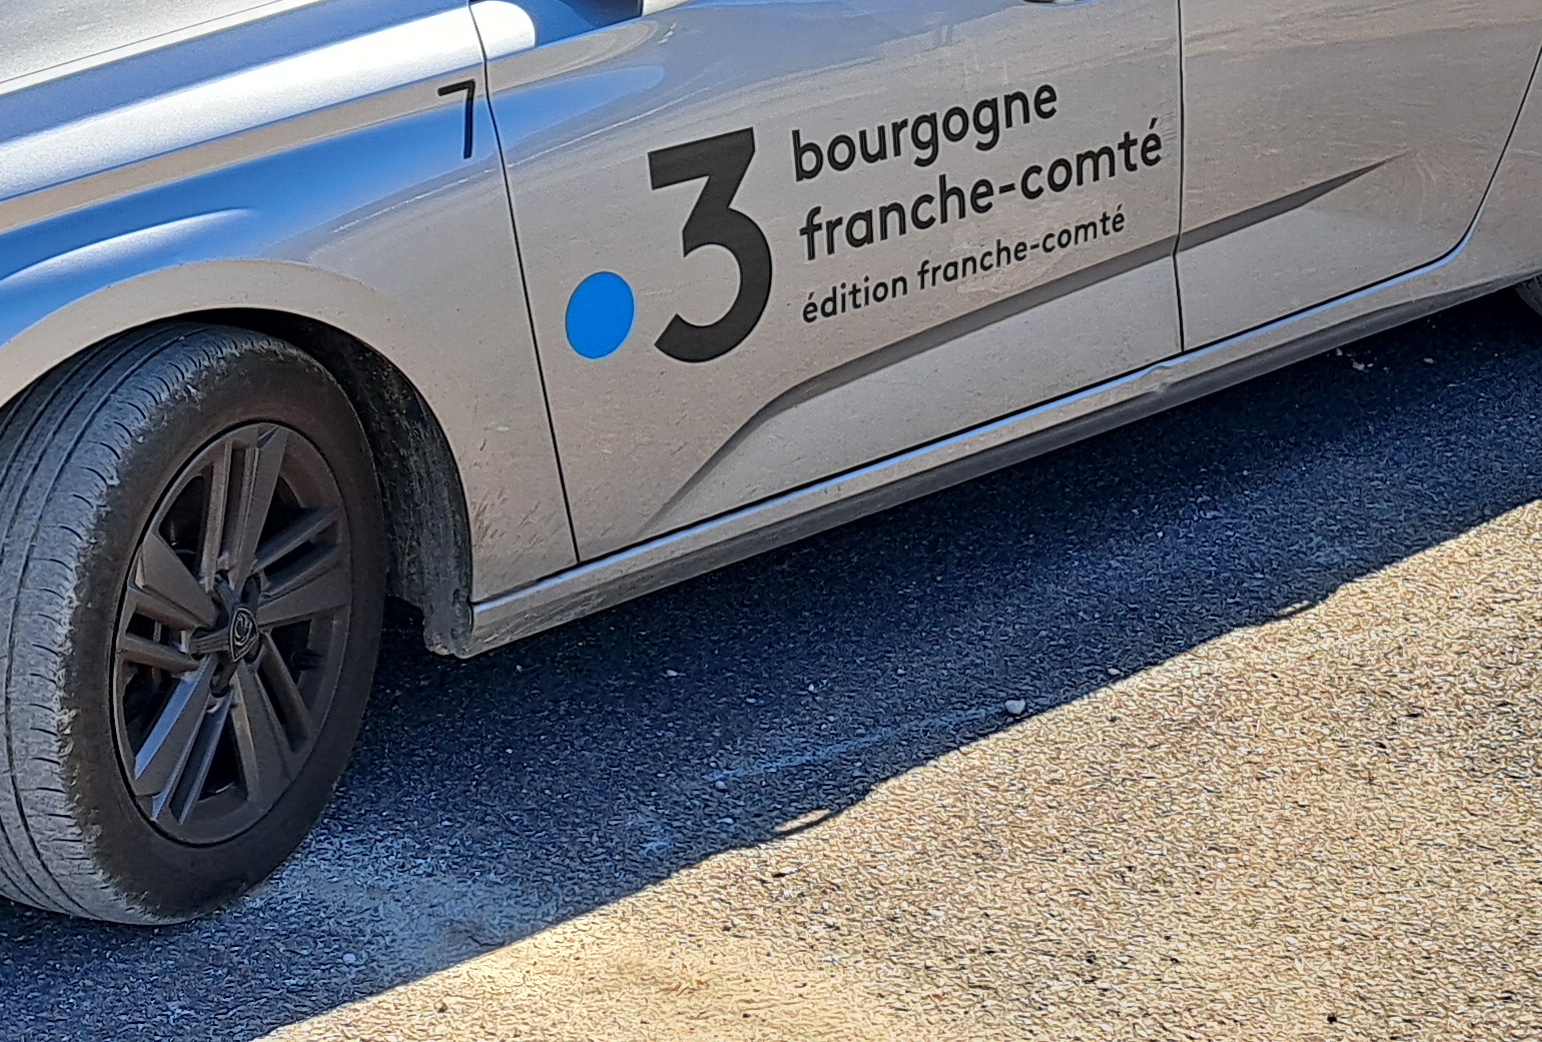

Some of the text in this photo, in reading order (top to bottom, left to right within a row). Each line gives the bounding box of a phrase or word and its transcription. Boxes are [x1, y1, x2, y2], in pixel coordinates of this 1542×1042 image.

[437, 78, 476, 160] 7
[791, 83, 1058, 183] bourgogne
[647, 127, 773, 363] 3
[798, 117, 1163, 261] franche-comté
[801, 203, 1126, 324] édition franche-comté
